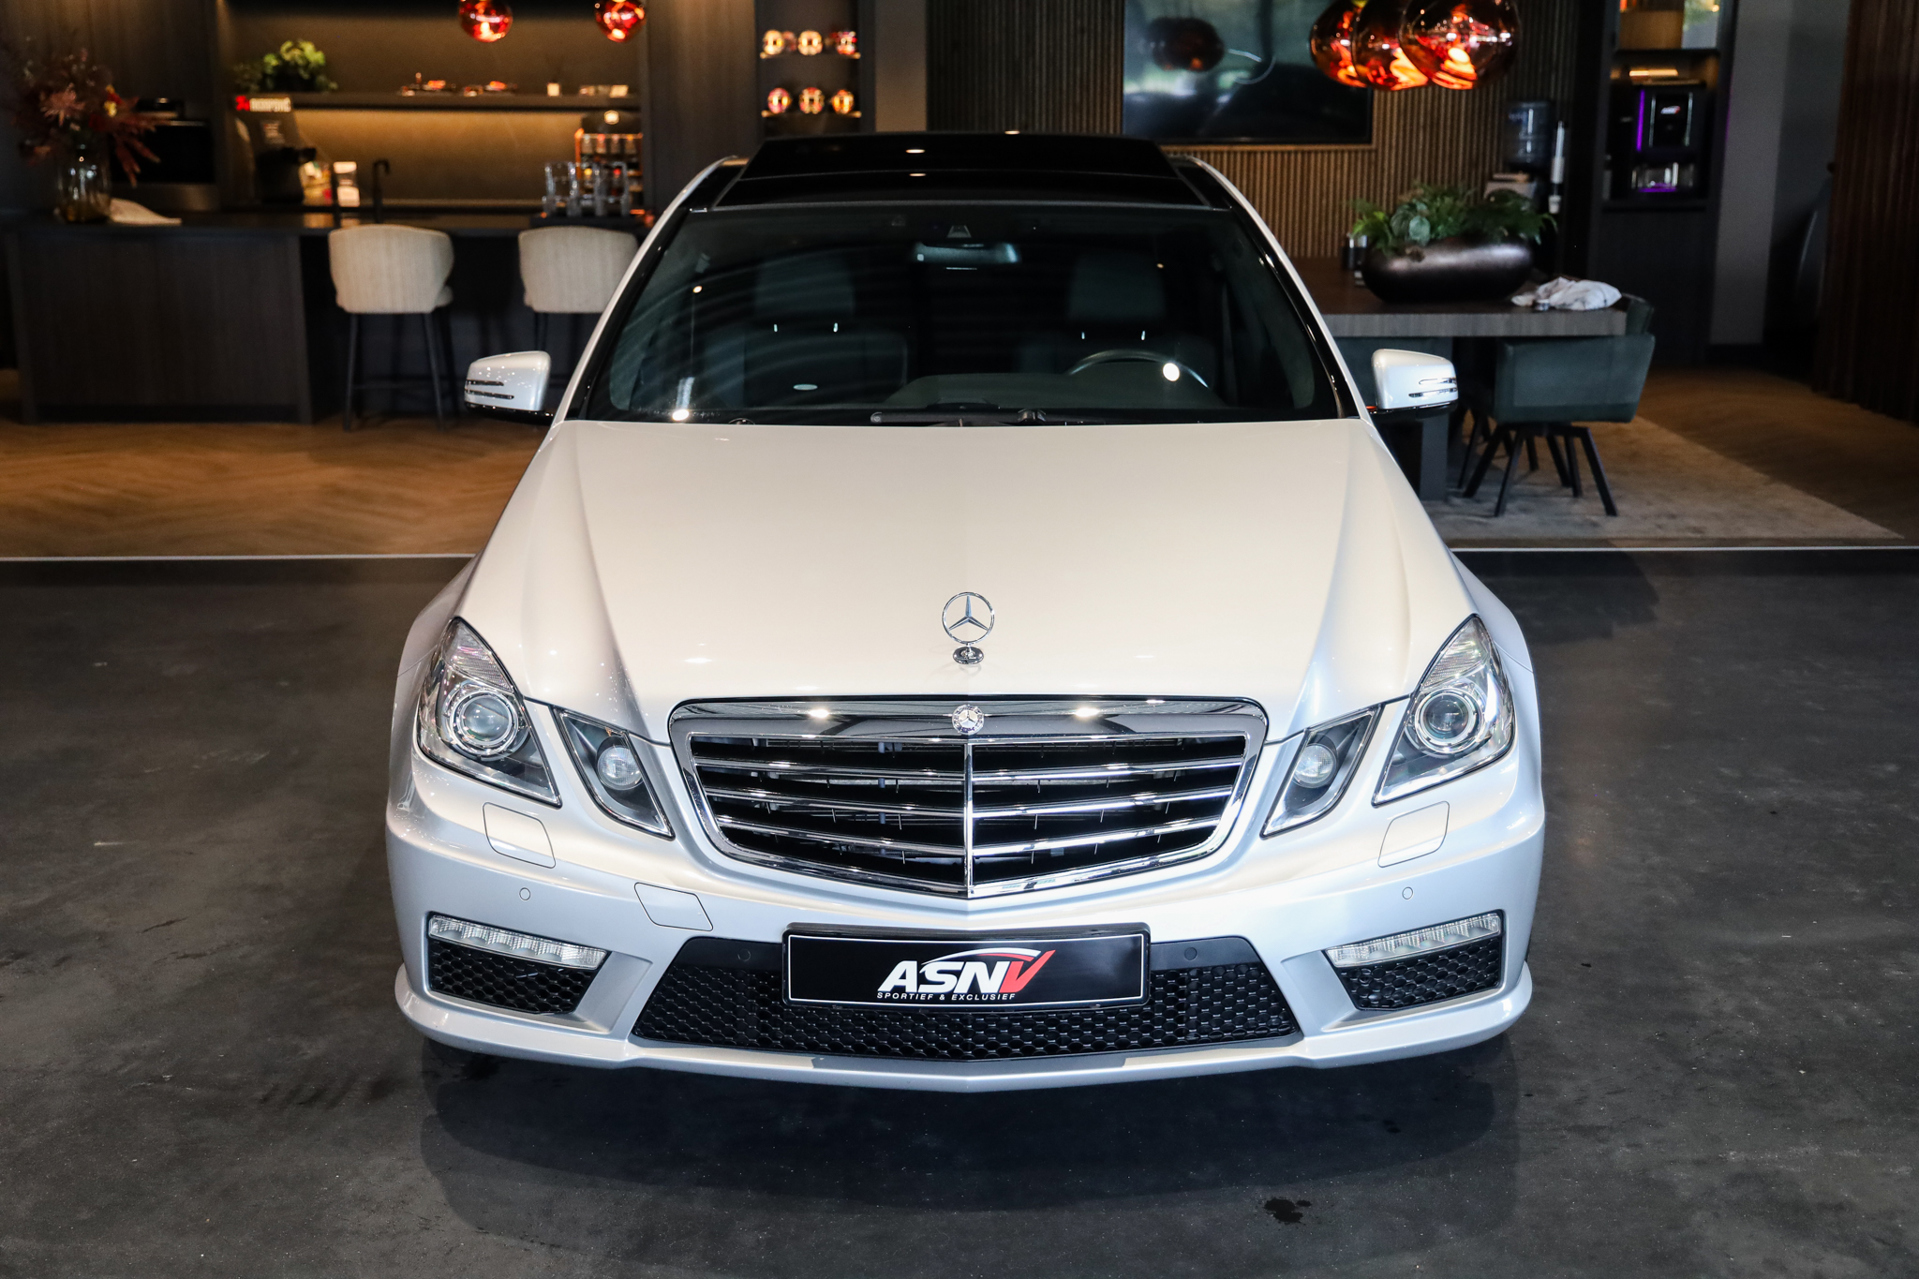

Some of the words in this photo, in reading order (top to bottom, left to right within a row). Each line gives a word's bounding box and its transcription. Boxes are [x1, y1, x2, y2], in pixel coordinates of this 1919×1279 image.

[876, 991, 934, 1001] SPORTIEF
[938, 993, 946, 1001] &
[951, 992, 1016, 1001] EXCLUSIEF
